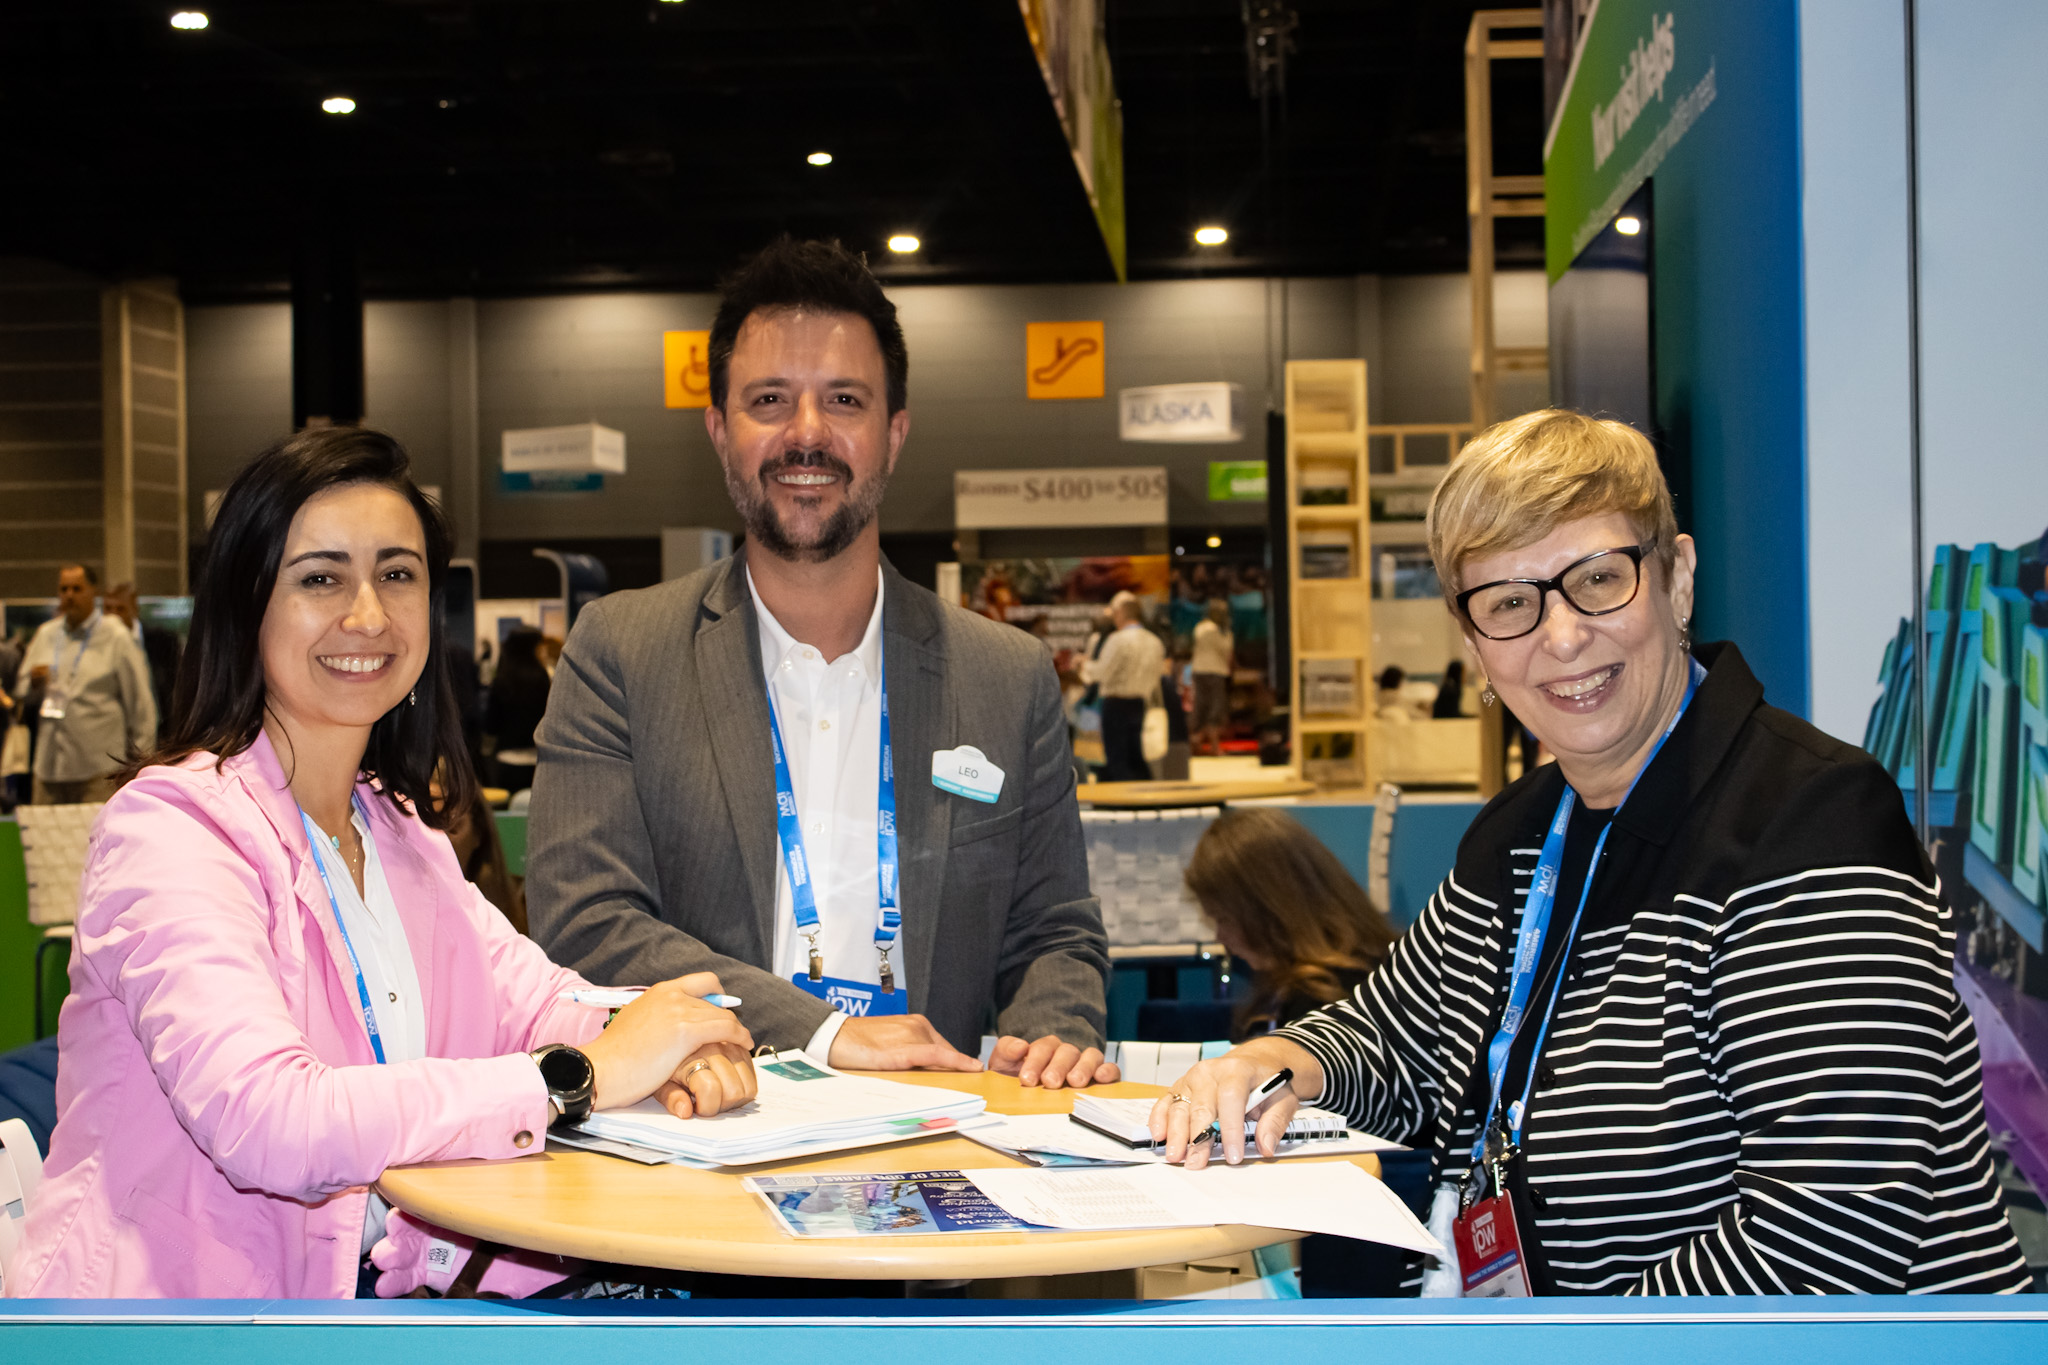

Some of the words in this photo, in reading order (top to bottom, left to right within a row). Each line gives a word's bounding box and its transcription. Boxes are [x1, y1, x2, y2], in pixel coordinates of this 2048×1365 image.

[1127, 401, 1216, 425] ALASKA
[958, 765, 979, 779] LEO
[823, 1174, 876, 1184] PARKS
[909, 1172, 928, 1180] OF
[1472, 1222, 1496, 1259] ipw
